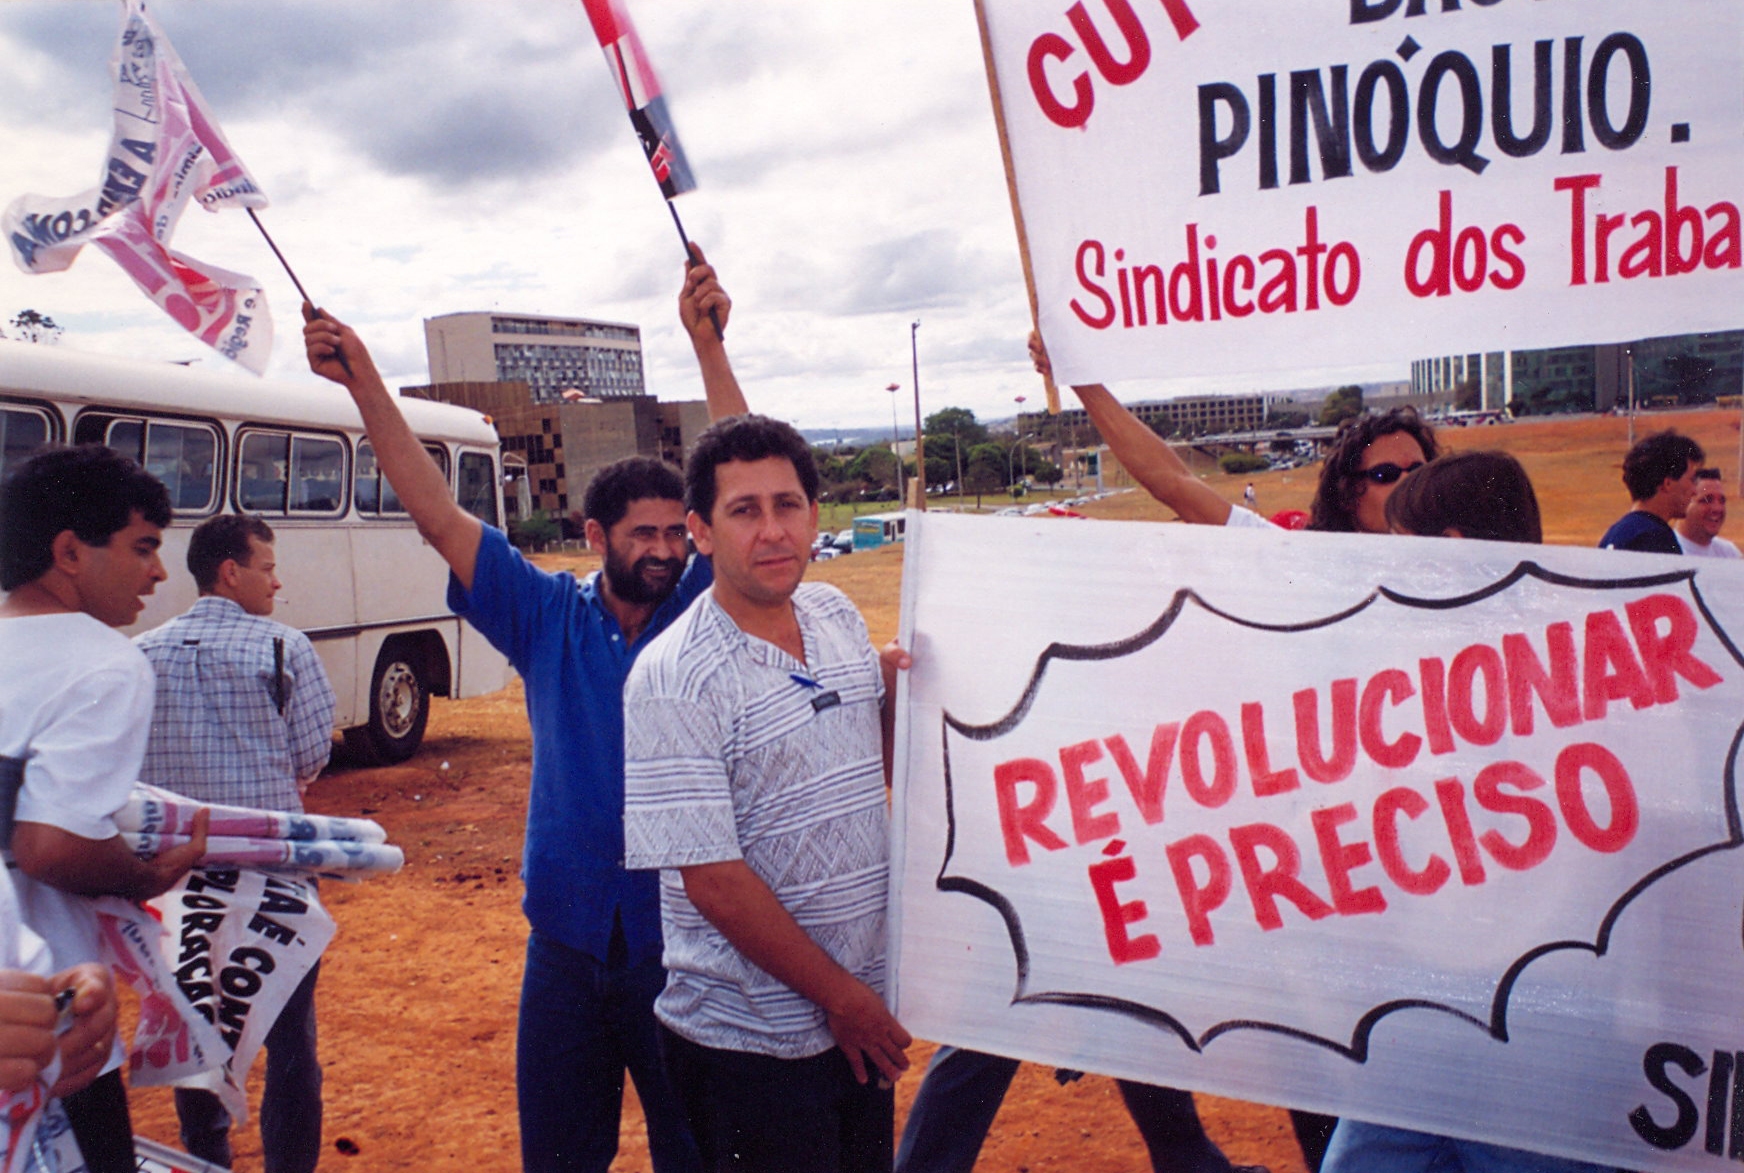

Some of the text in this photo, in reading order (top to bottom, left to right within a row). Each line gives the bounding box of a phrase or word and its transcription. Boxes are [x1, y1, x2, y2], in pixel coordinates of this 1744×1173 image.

[1198, 33, 1690, 195] PINÓQUIO.
[1070, 166, 1743, 330] Sindicato dos Traba
[994, 594, 1723, 867] REVOLUCIONAR
[247, 911, 307, 947] É
[1088, 742, 1640, 966] É PRECISO
